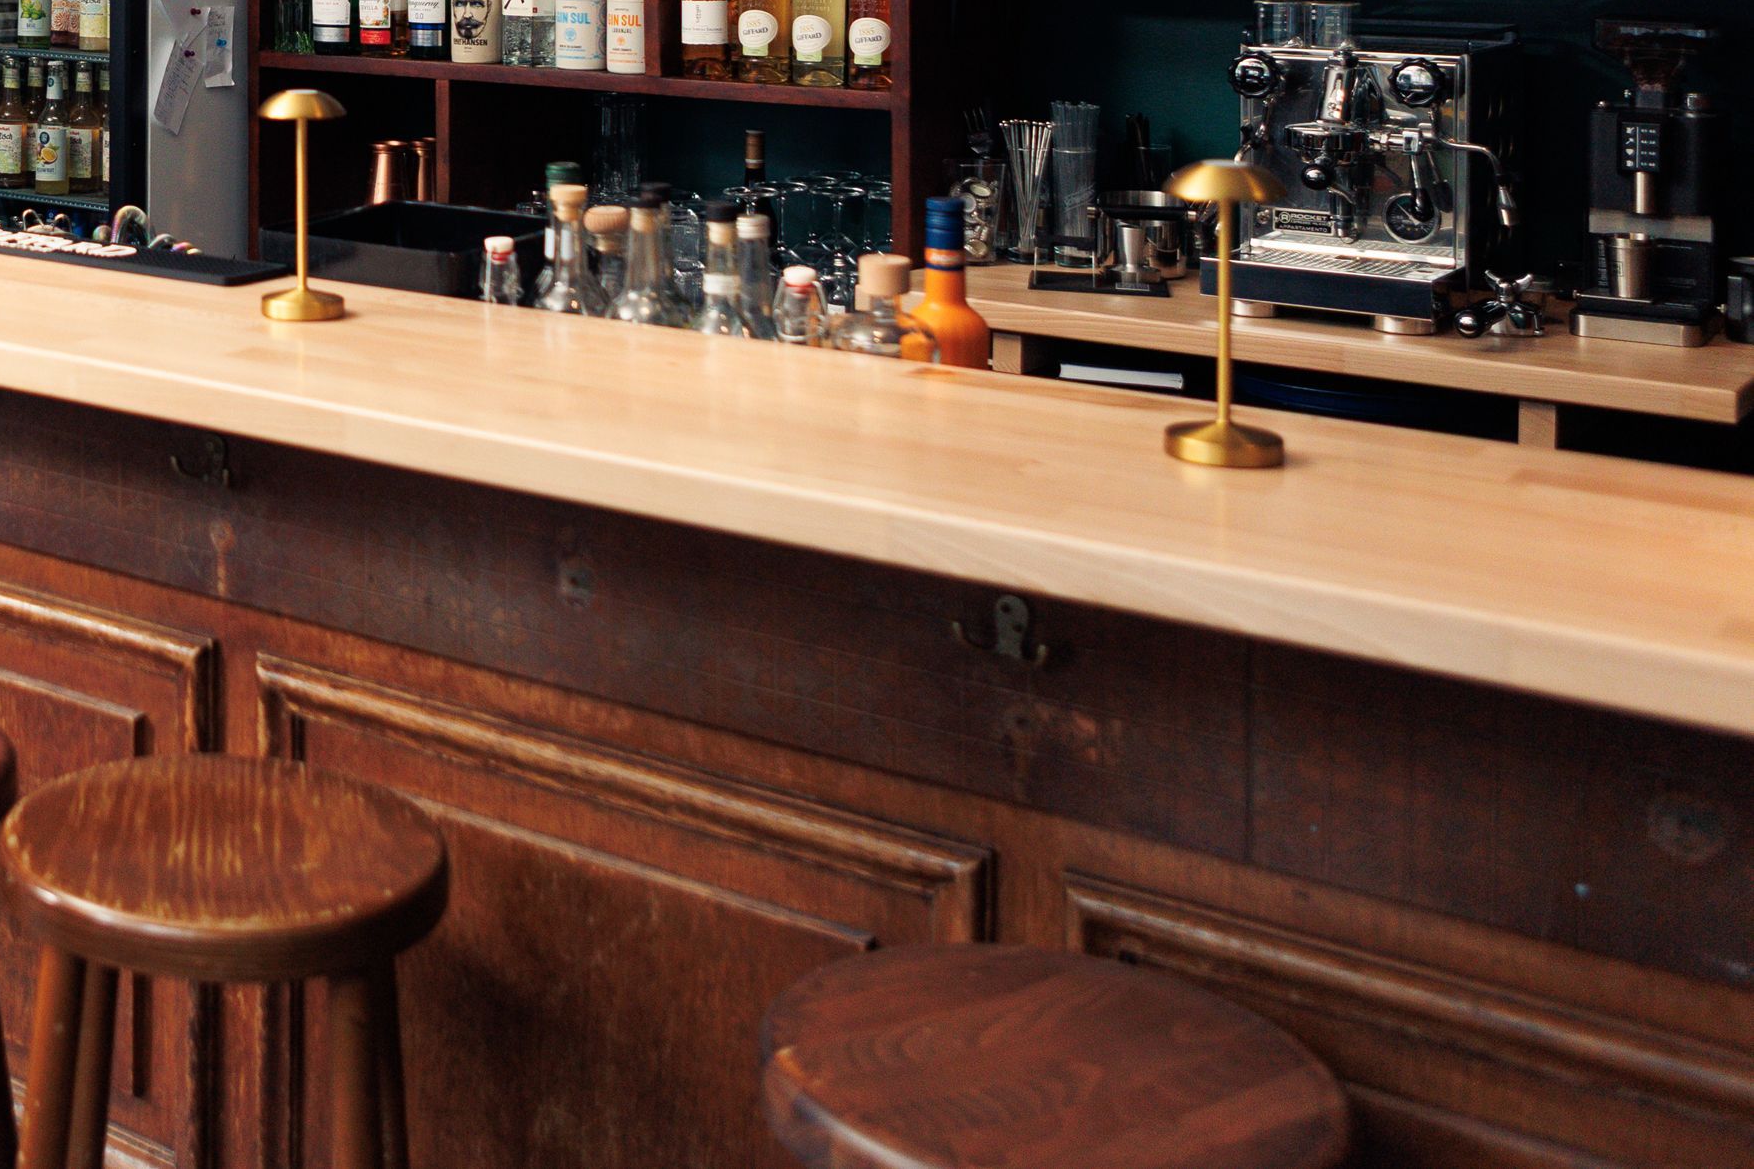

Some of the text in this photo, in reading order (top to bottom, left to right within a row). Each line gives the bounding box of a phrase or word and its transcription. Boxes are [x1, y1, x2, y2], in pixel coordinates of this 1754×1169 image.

[570, 12, 591, 25] SUL
[621, 14, 642, 27] SUL
[742, 27, 769, 36] GIFFARD
[796, 32, 822, 40] GIFFARD
[461, 38, 488, 46] HANSEN
[854, 35, 882, 44] GIFFARD
[1290, 213, 1327, 221] ROCKET
